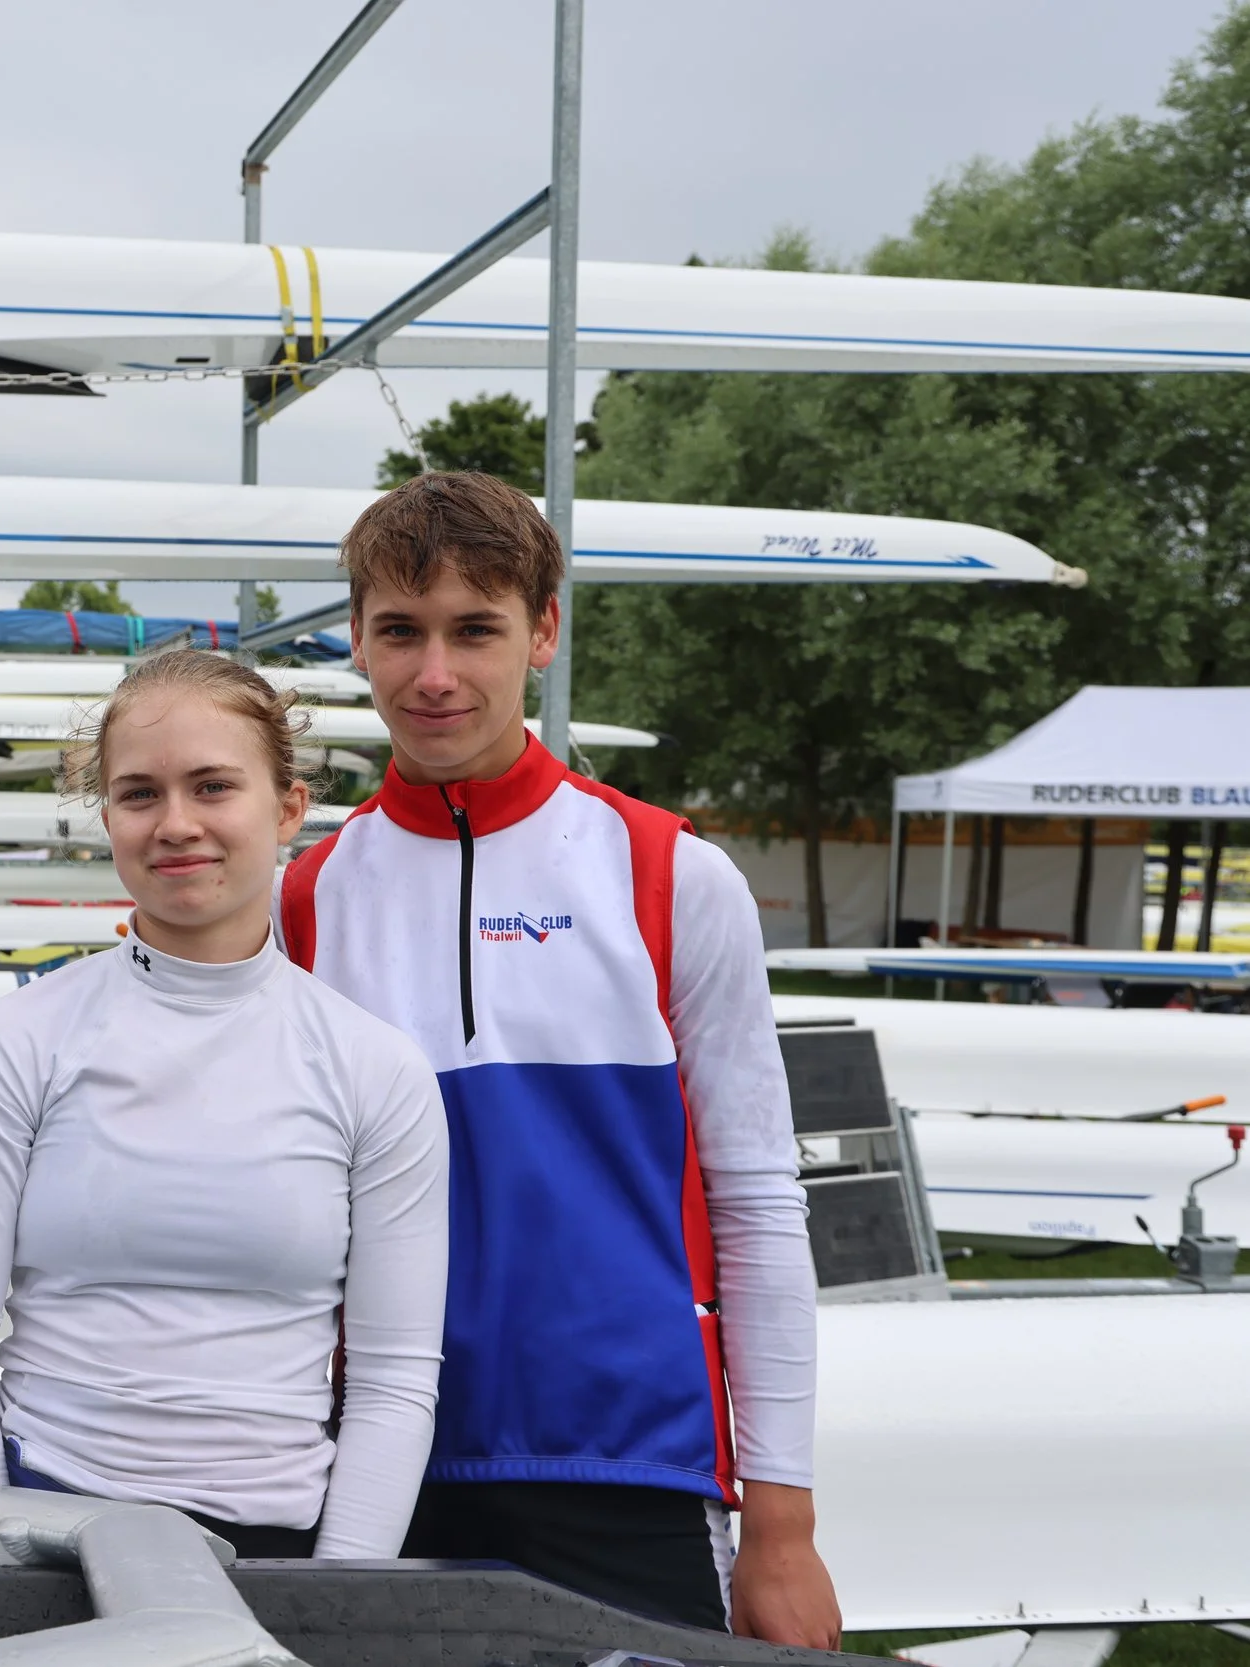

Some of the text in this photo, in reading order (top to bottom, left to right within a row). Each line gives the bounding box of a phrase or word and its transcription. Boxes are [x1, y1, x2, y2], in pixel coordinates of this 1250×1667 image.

[761, 534, 821, 556] Wind
[1032, 785, 1181, 804] RUDERCLUB
[479, 915, 572, 931] RUDER CLUB
[479, 930, 522, 942] Thalwil
